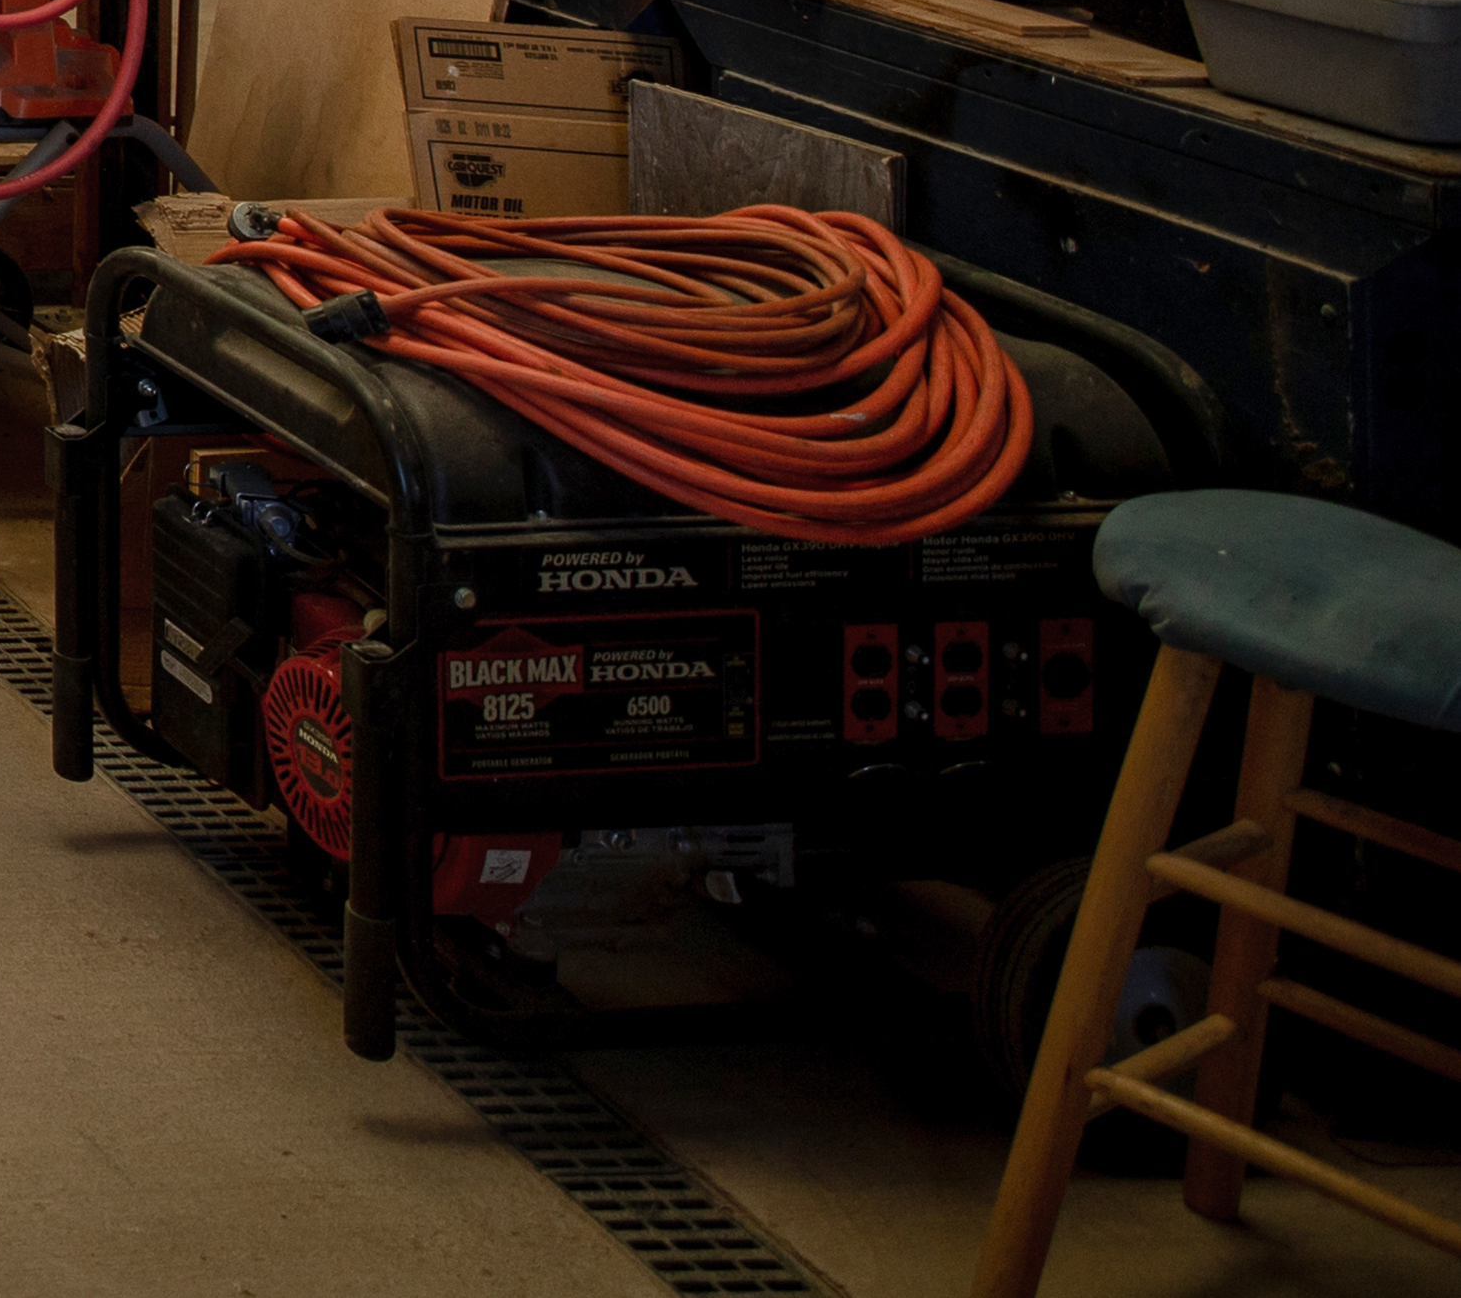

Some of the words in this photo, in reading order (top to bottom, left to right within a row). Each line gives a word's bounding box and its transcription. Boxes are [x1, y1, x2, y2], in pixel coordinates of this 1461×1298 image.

[446, 159, 506, 177] CARQUEST
[450, 193, 500, 212] MOTOR
[502, 195, 524, 215] OIL
[740, 542, 781, 554] Honda
[922, 535, 960, 547] Motor
[960, 534, 1001, 546] Honda
[541, 551, 622, 568] POWERED
[625, 551, 646, 567] by
[537, 566, 699, 593] HONDA
[592, 650, 655, 664] POWERED
[658, 649, 674, 662] by
[449, 657, 524, 690] BLACK
[526, 654, 577, 684] MAX
[589, 661, 716, 683] HONDA
[483, 693, 536, 723] 8125
[626, 695, 672, 717] 6500
[474, 722, 519, 733] MAXIMUM
[520, 720, 551, 731] WATTS
[604, 725, 636, 736] VATIOS
[637, 725, 650, 735] DE
[650, 723, 694, 734] TRABAJO
[474, 730, 507, 741] VATIOS
[298, 726, 340, 766] HONDA
[471, 758, 509, 770] PORTABLE
[510, 755, 554, 768] GENERATOR
